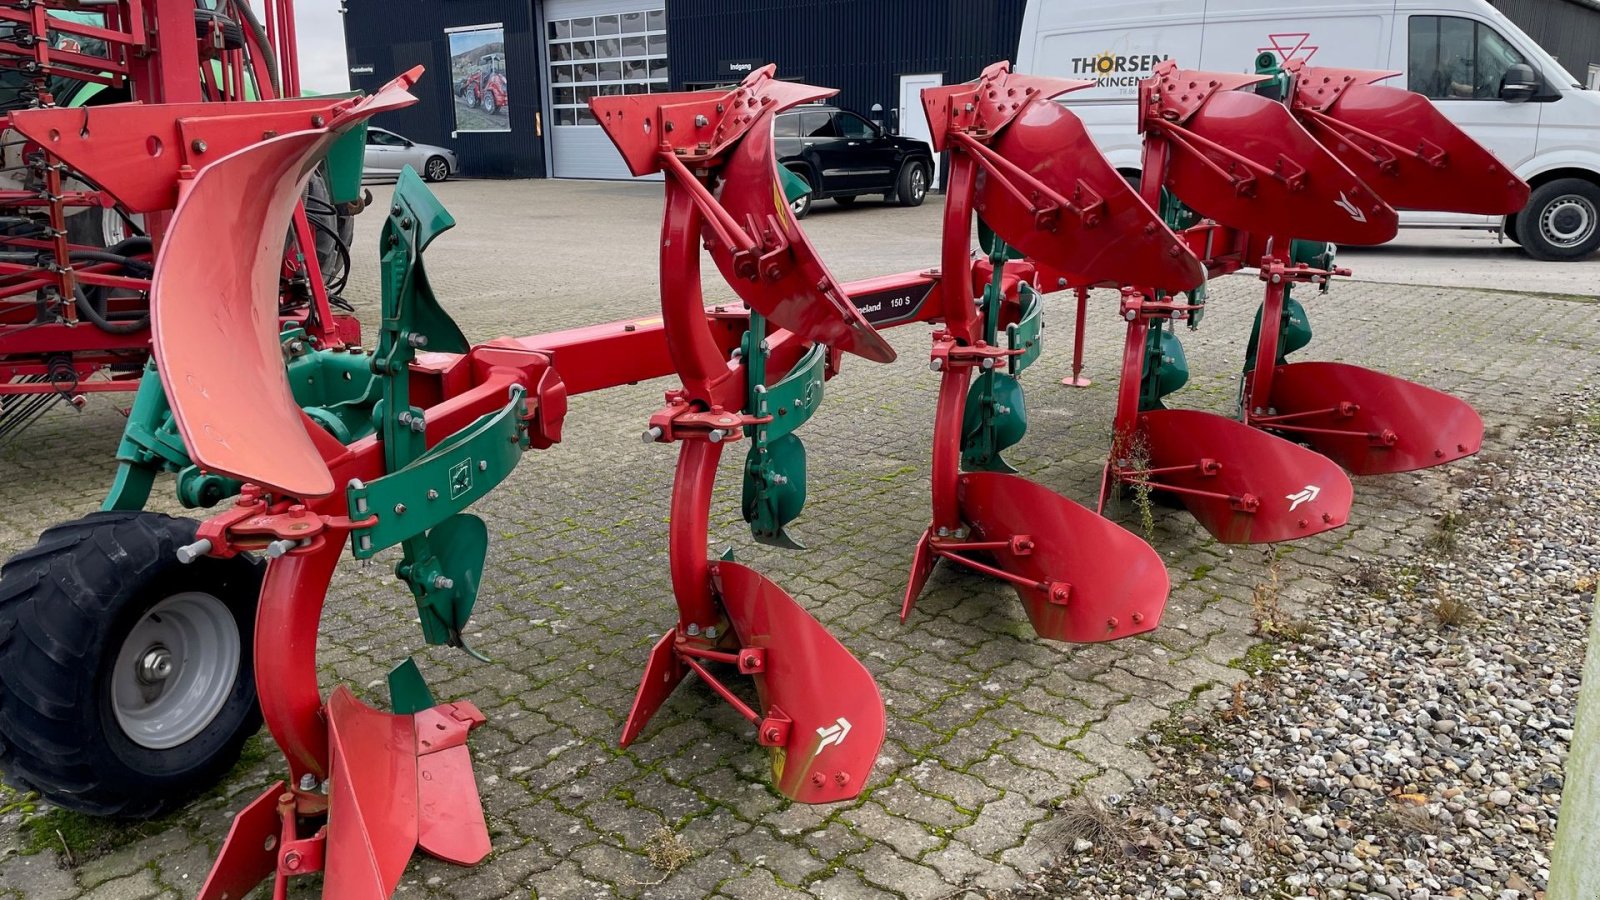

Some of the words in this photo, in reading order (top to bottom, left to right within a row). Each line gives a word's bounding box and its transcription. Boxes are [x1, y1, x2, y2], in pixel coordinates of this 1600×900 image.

[730, 63, 752, 71] Indgang
[890, 298, 903, 308] 150
[904, 296, 911, 305] S
